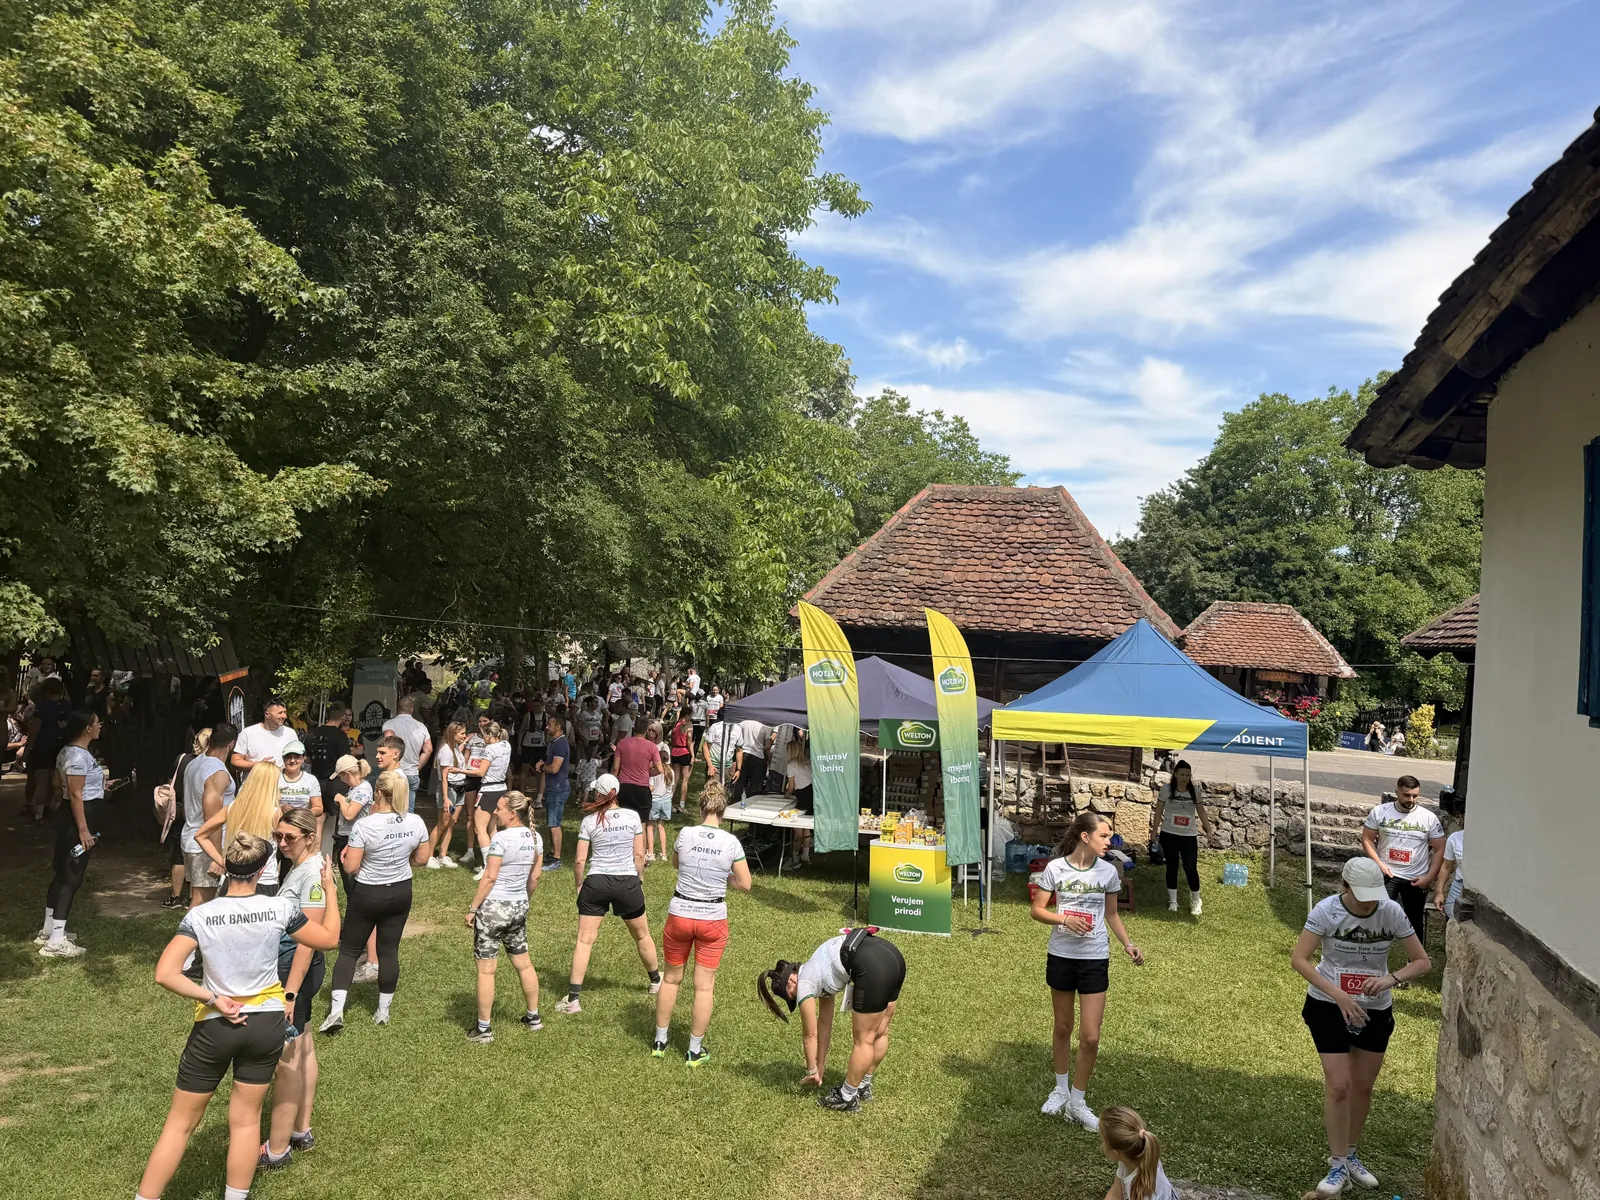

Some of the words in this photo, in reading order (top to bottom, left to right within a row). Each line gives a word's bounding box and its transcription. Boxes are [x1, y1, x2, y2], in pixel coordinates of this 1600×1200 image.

[903, 731, 932, 739] WELTON
[1226, 731, 1285, 747] ADIENT
[382, 830, 414, 841] ADIENT
[689, 844, 722, 856] ADIENT
[1392, 852, 1406, 860] 526
[898, 870, 921, 878] WELTON
[891, 895, 924, 906] Verujem
[205, 914, 227, 926] ARK
[229, 908, 277, 925] BANOVIĆI
[894, 906, 921, 917] prirodi
[1362, 955, 1368, 963] 5
[1347, 978, 1362, 990] 62
